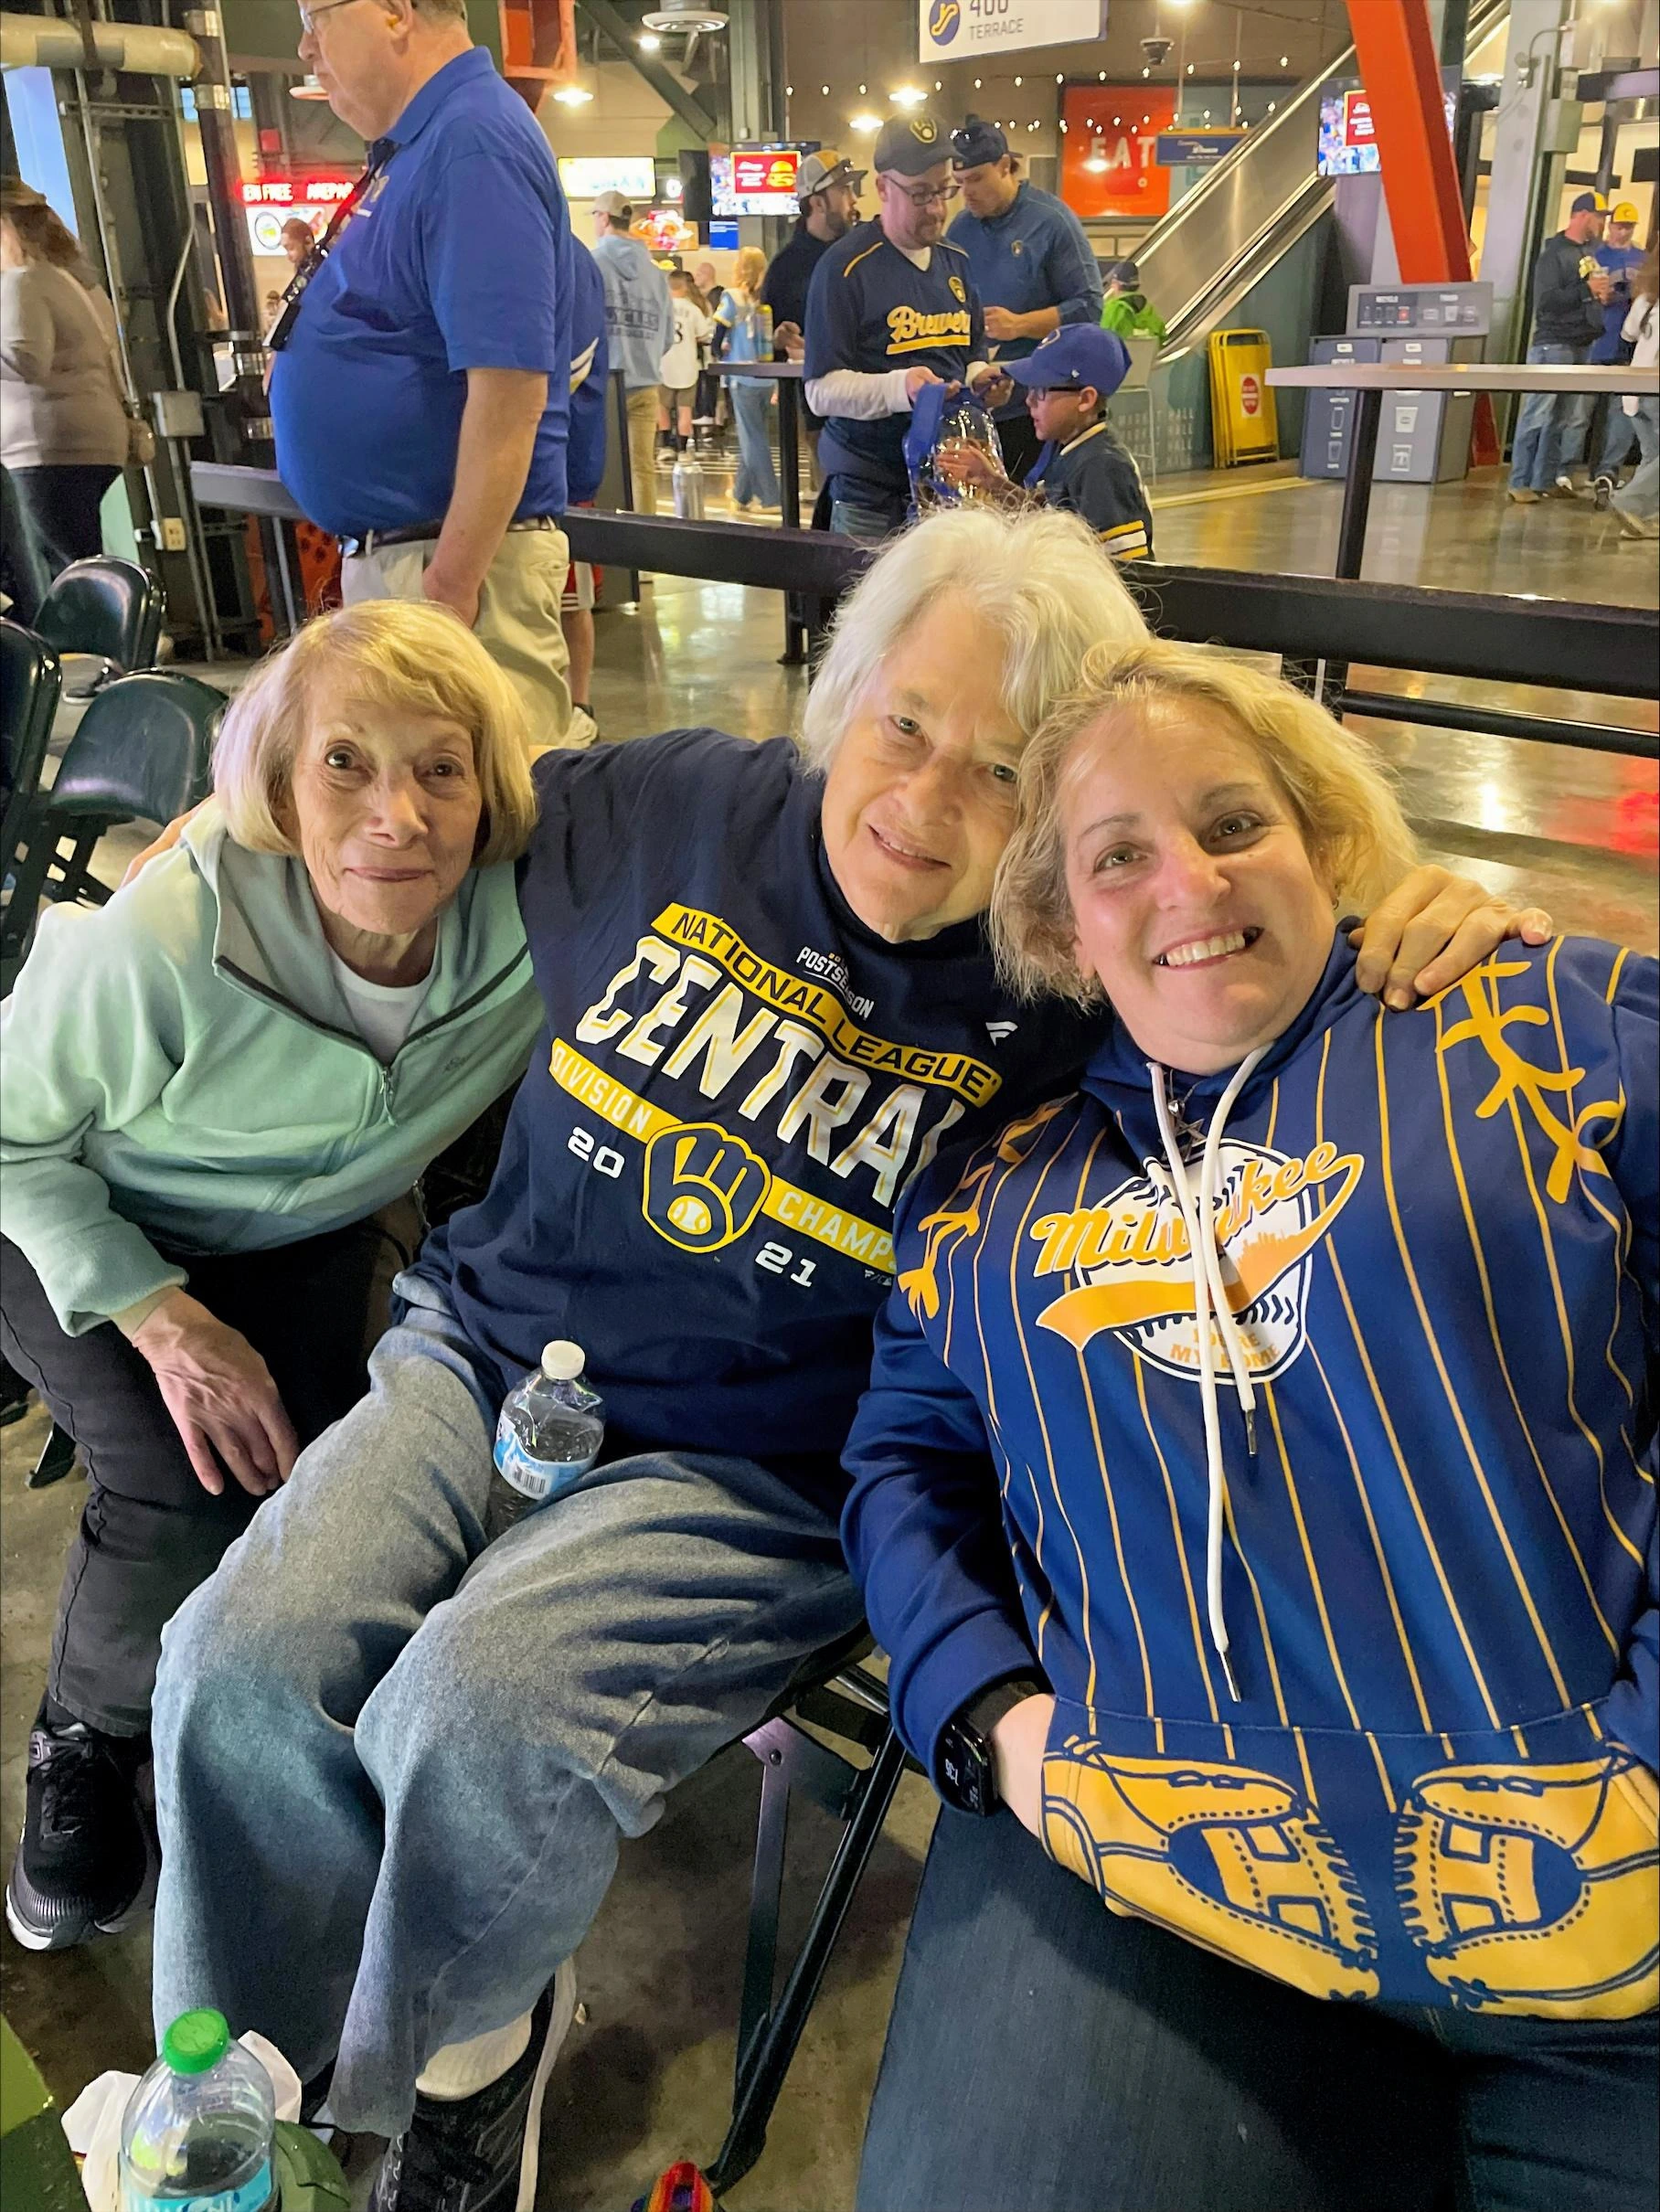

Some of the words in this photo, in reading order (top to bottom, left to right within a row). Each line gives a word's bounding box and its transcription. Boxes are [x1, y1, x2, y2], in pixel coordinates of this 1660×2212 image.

[969, 18, 1025, 40] TERRACE
[1090, 136, 1156, 169] EAT
[670, 911, 827, 1025] NATIONAL
[831, 1018, 993, 1100] LEAGUE
[795, 945, 875, 1022] POSTSESON
[553, 1045, 654, 1134] DIVISION
[567, 1125, 626, 1179] 20
[754, 1240, 818, 1289] 21
[1029, 1142, 1357, 1277] Milwukee
